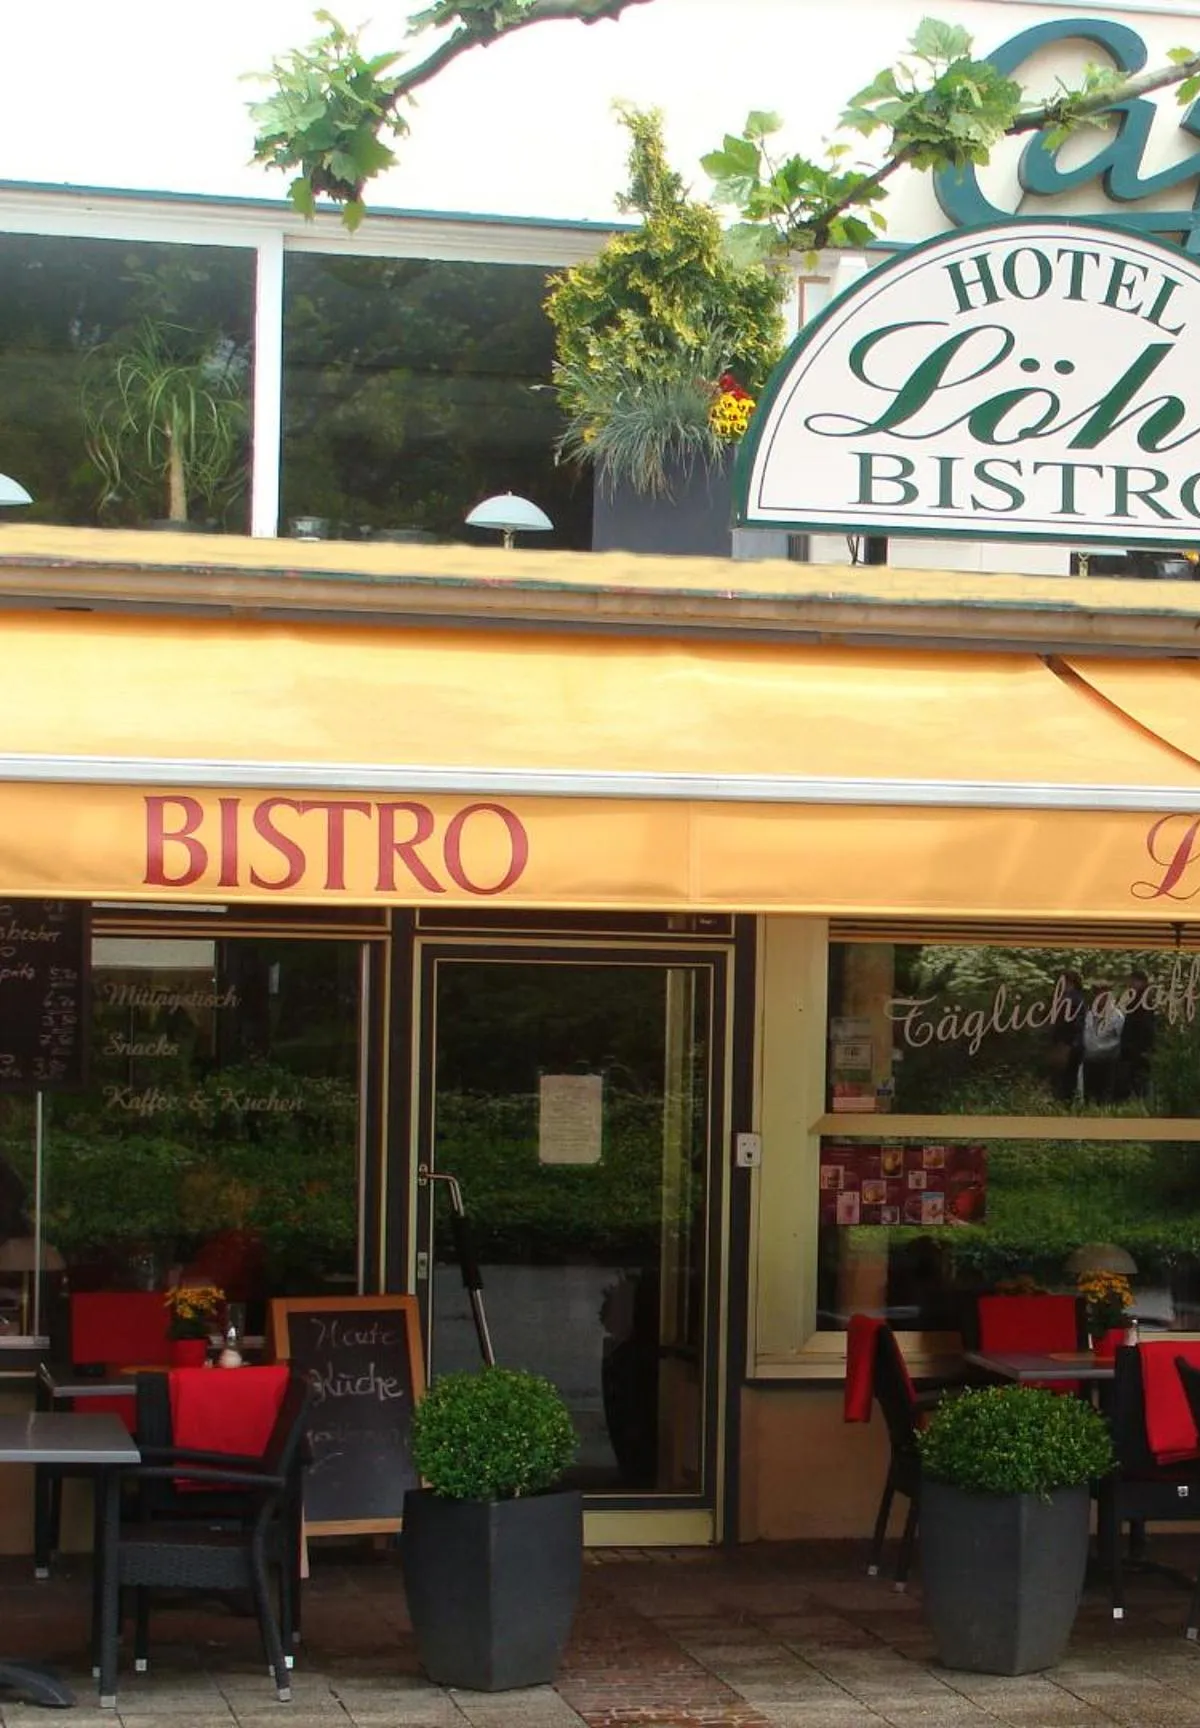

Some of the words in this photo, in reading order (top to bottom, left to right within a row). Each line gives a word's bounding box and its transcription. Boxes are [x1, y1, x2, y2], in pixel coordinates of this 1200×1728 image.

[940, 246, 1187, 337] HOTEL
[142, 795, 530, 896] BISTRO
[102, 1031, 180, 1057] Snacks
[883, 974, 1086, 1057] Täglich
[310, 1317, 397, 1349] Heute
